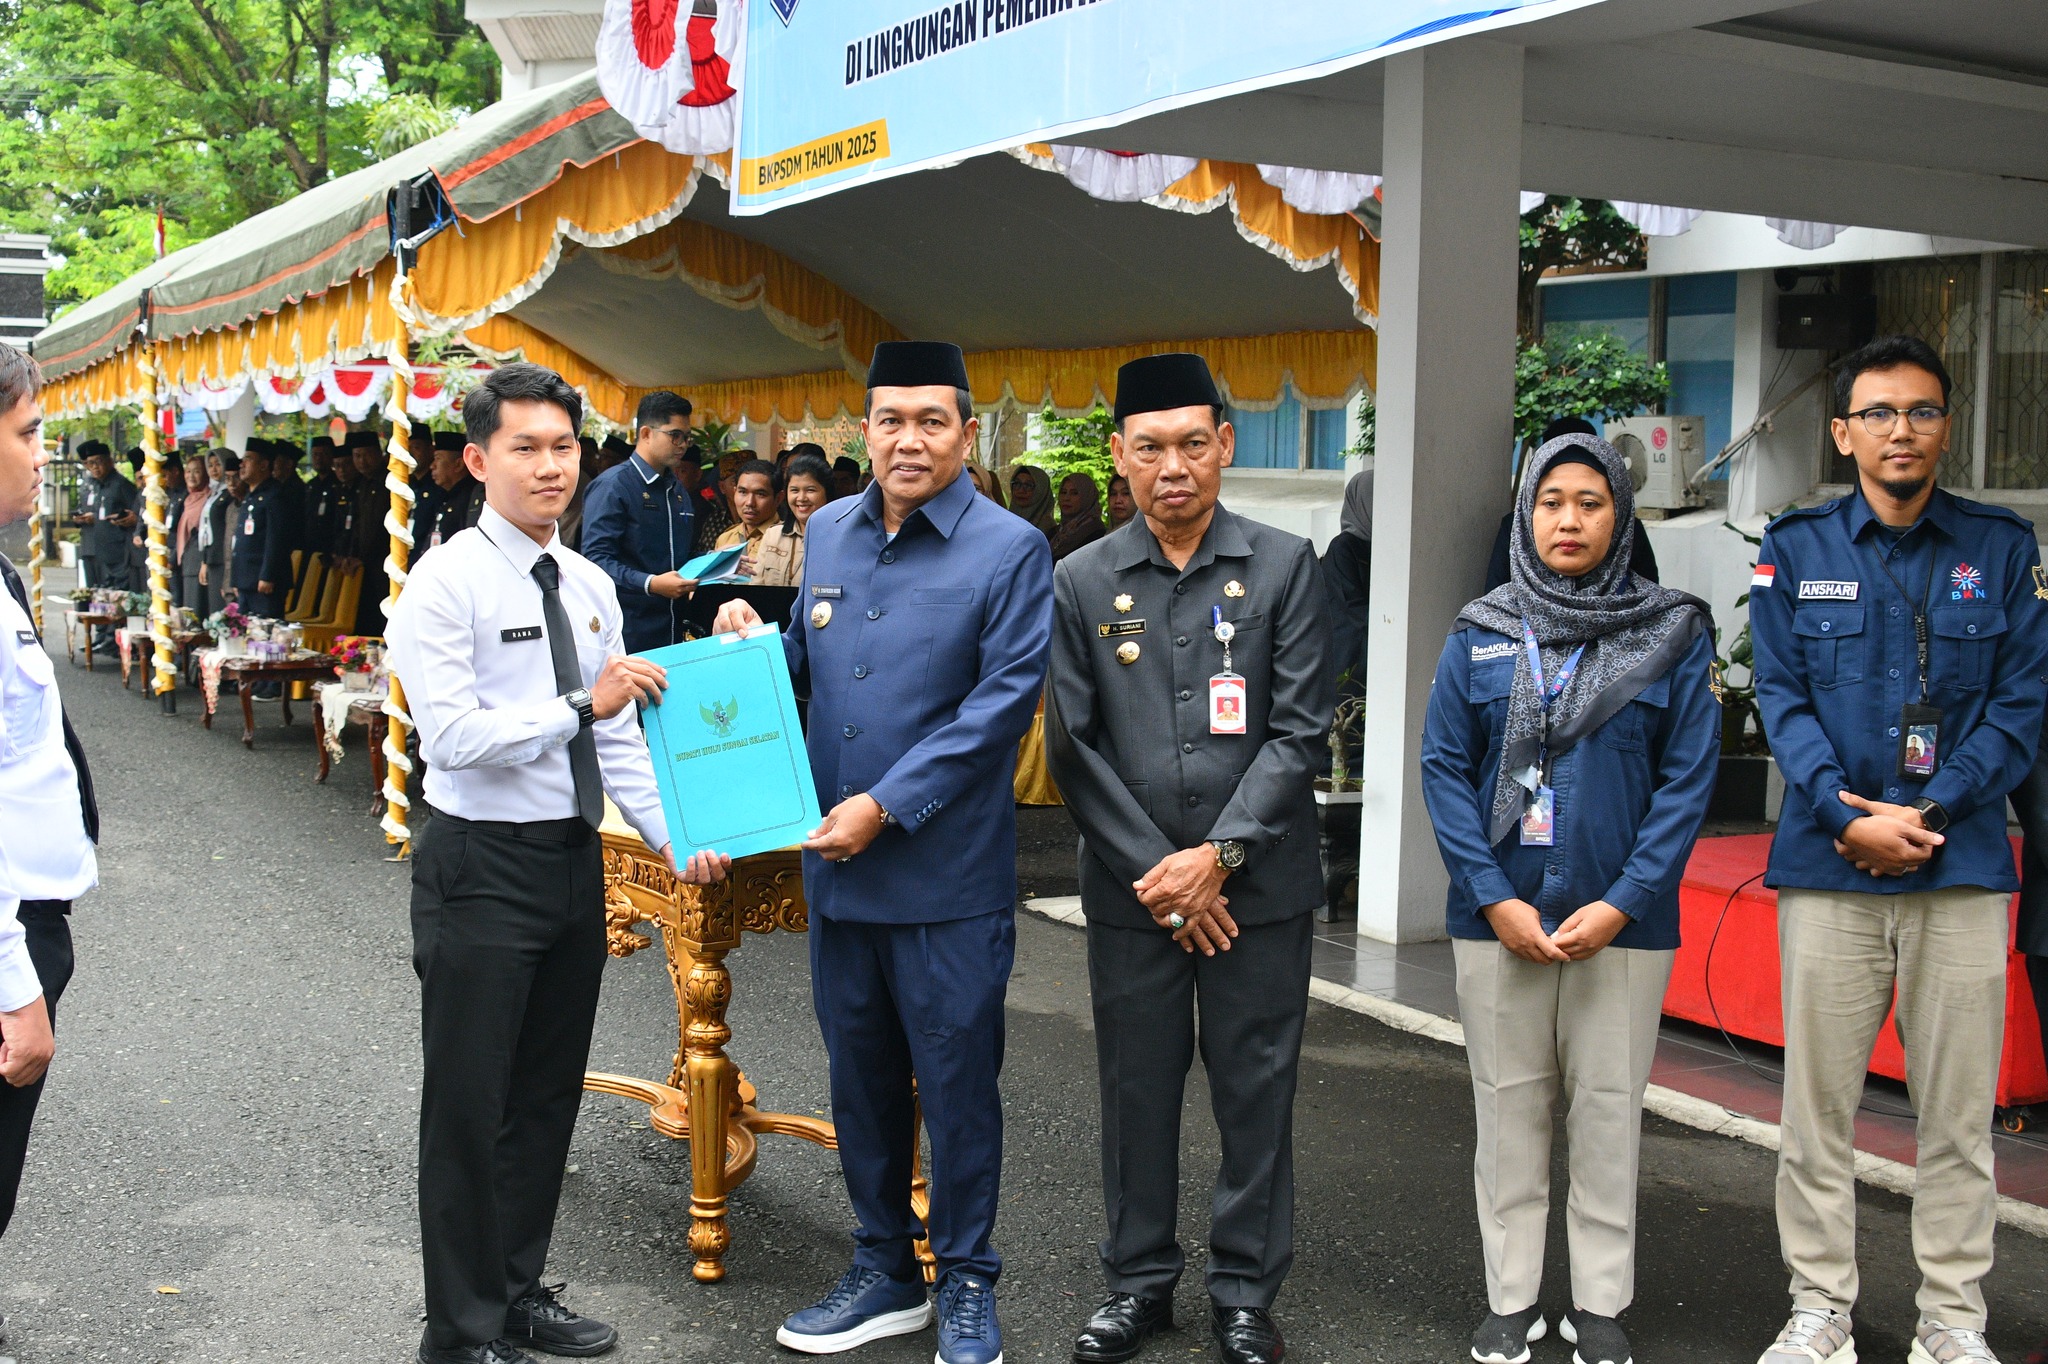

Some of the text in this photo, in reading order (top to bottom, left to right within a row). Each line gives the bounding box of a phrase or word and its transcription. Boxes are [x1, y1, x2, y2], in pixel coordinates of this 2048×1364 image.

[845, 41, 862, 85] DI
[866, 0, 977, 79] LINGKUNGAN
[758, 130, 877, 186] BKPSDM TAHUN 2025
[1653, 453, 1666, 463] LG
[1802, 584, 1855, 597] ANSHARI
[1951, 589, 1986, 600] BKN
